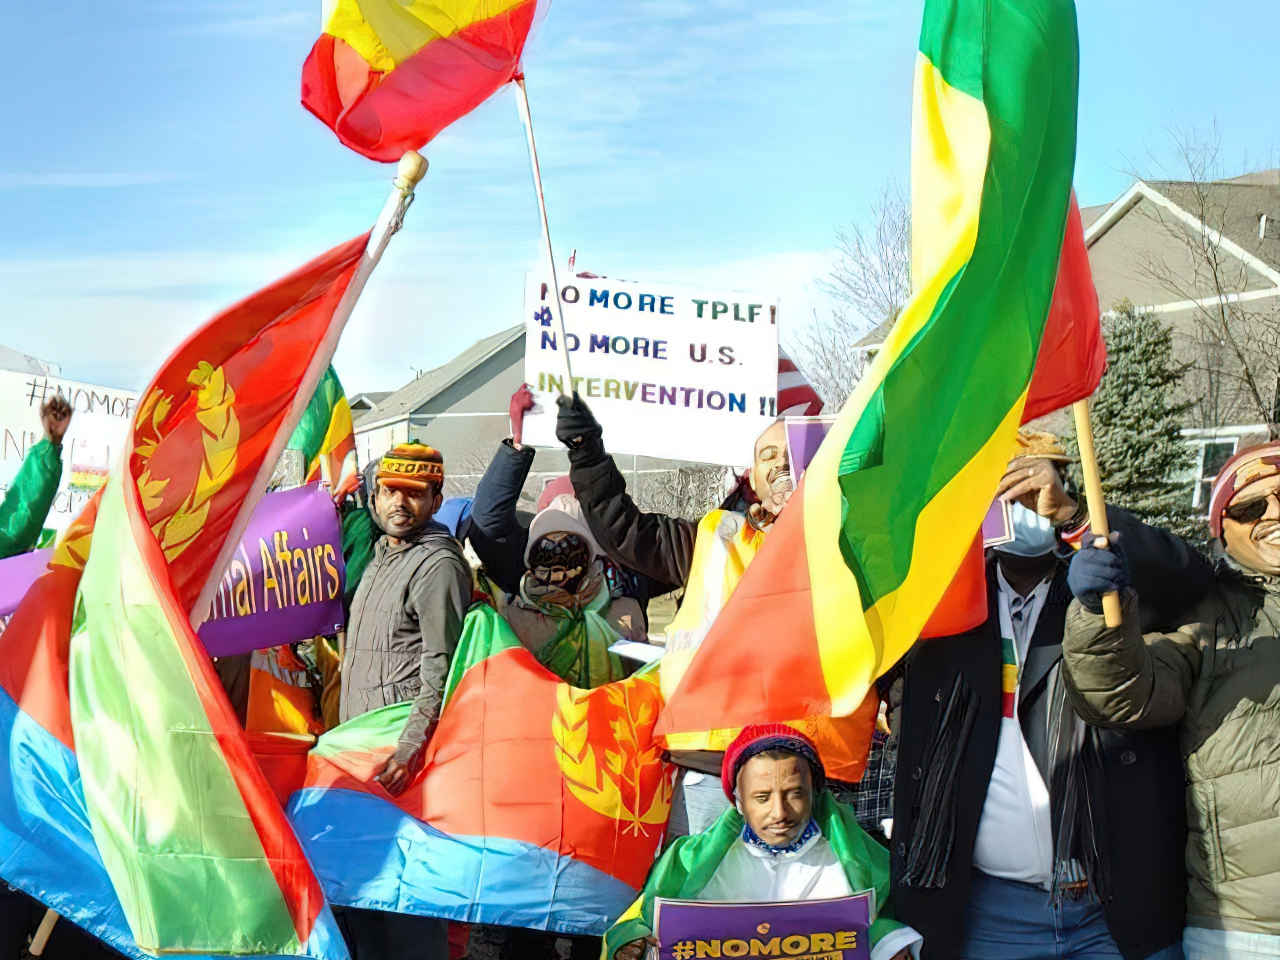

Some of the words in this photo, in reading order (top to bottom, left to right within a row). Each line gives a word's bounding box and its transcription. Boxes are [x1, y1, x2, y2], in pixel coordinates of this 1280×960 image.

[589, 288, 674, 315] MORE
[541, 331, 581, 352] NO
[589, 333, 668, 360] MORE
[689, 343, 743, 366] U.S.
[538, 372, 746, 414] INTERVENTION
[259, 527, 340, 612] Affairs
[671, 931, 857, 960] #NOMORE
